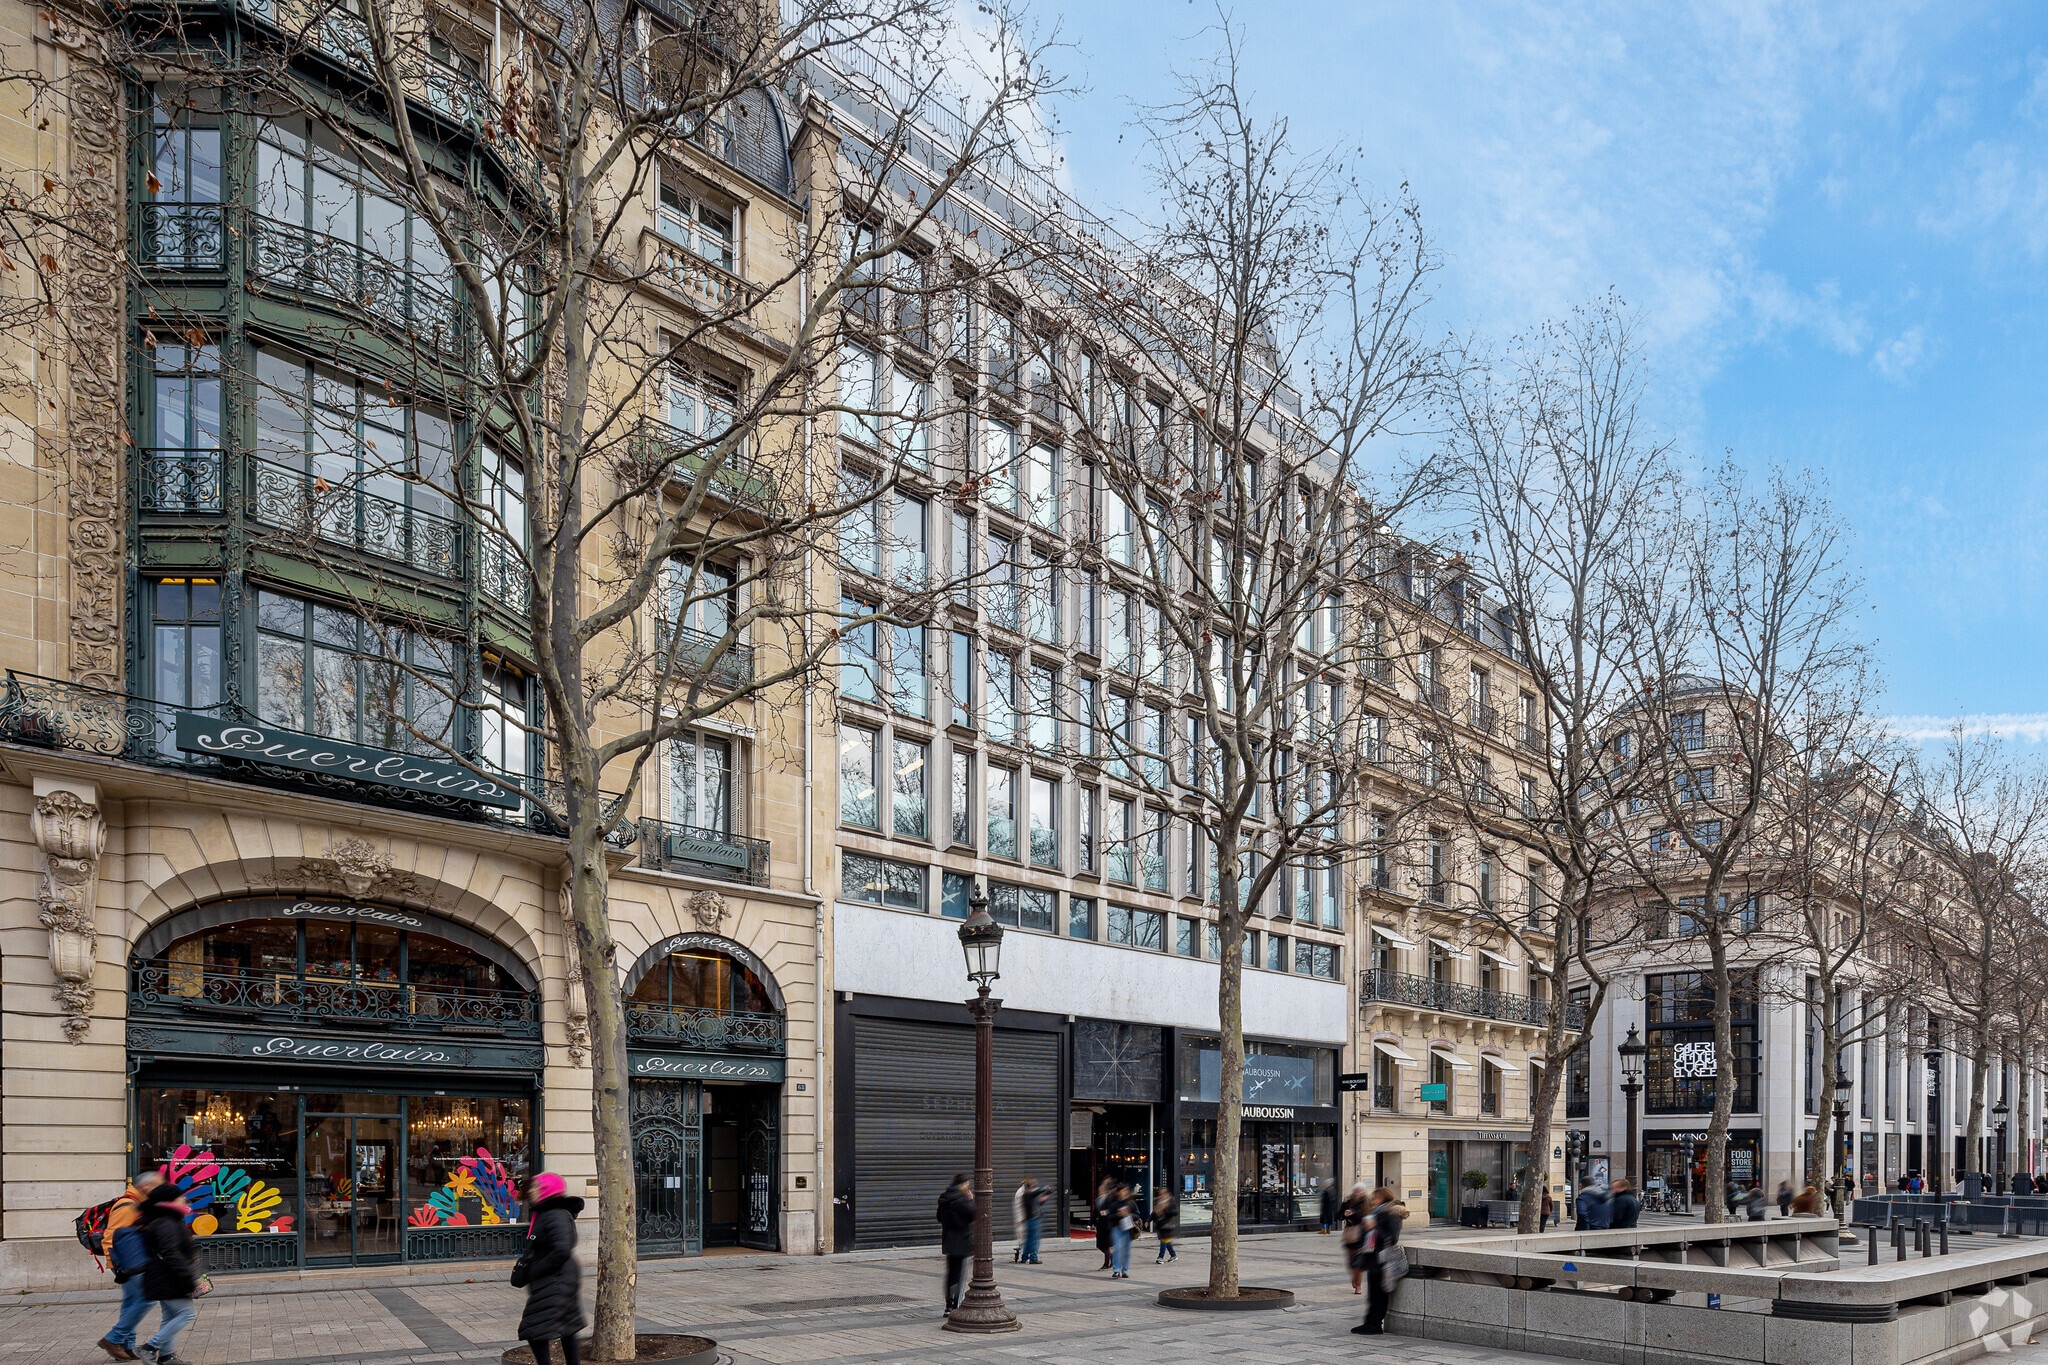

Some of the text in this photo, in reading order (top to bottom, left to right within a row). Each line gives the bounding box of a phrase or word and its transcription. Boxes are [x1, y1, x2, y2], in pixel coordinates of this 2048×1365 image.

[197, 727, 505, 798] Guerlain
[675, 839, 743, 862] Guerlain
[283, 902, 422, 927] Guerlain
[664, 936, 750, 961] Guerlain
[252, 1037, 450, 1062] Guerlain
[637, 1057, 769, 1076] Guerlain
[1672, 1132, 1733, 1141] MNOX
[1731, 1150, 1752, 1159] FOOD
